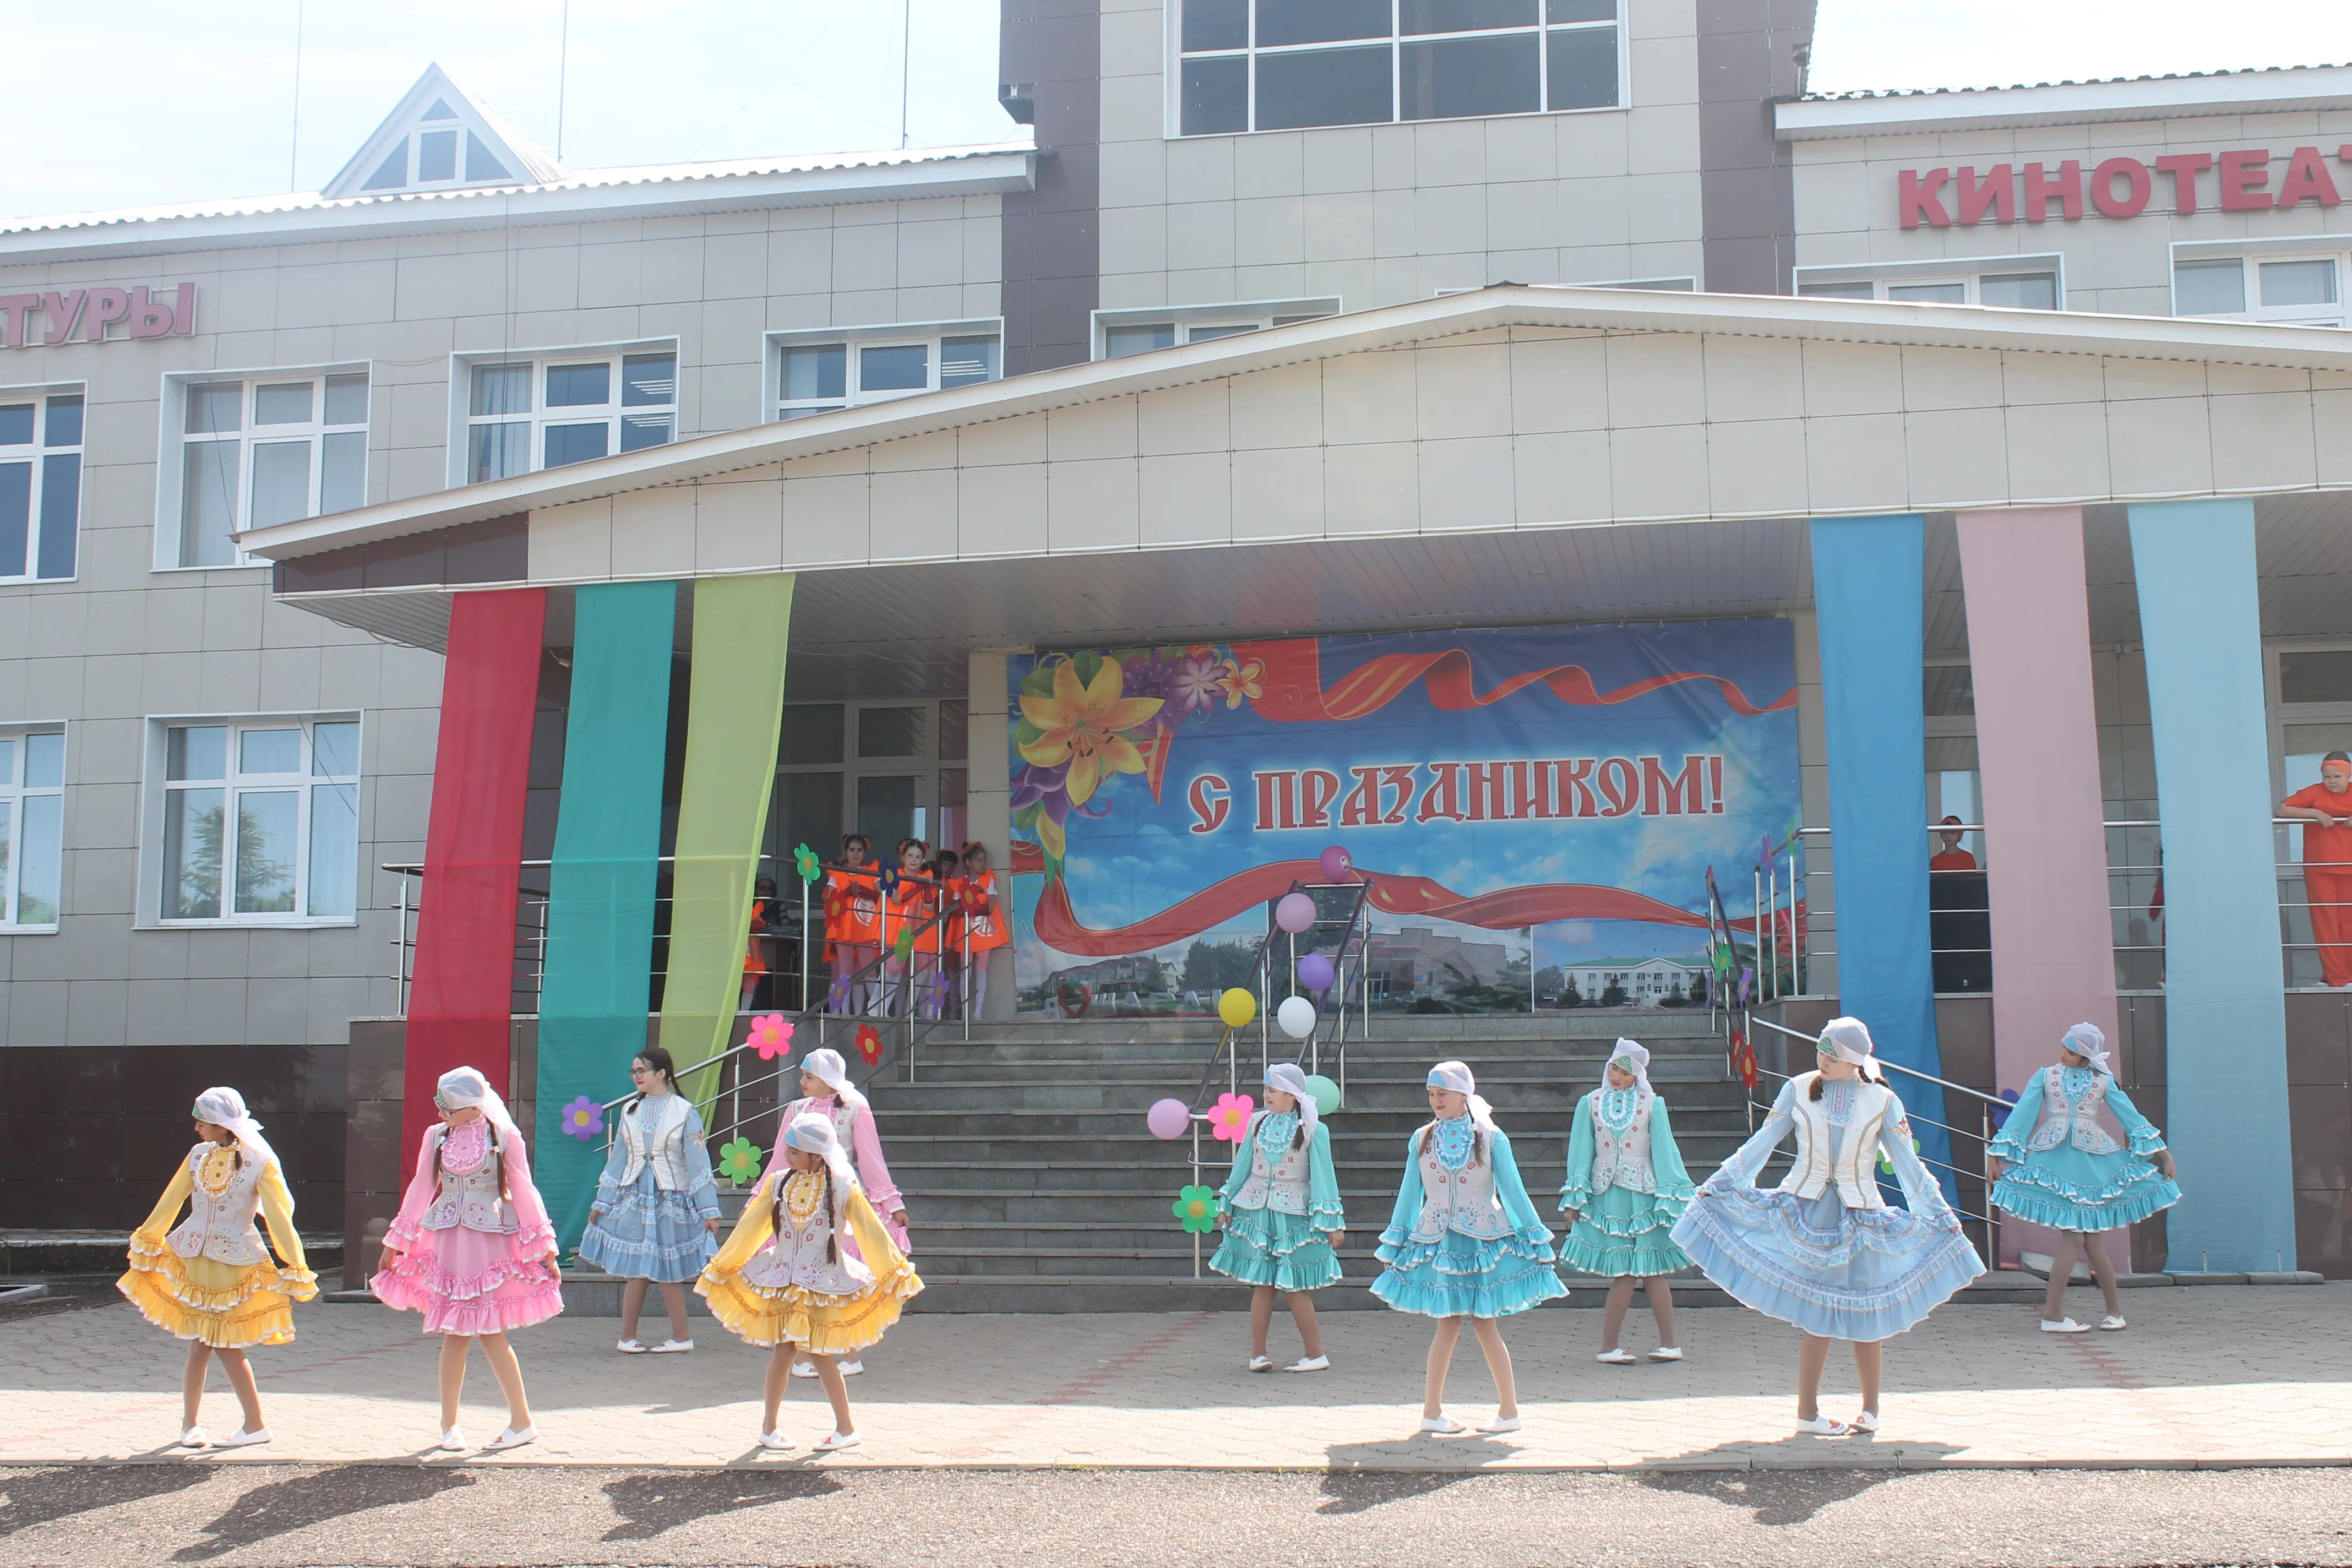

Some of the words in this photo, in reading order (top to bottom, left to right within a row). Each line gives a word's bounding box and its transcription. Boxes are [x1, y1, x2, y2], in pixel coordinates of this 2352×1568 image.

[1898, 144, 2352, 230] КИНОТЕА
[0, 282, 197, 347] ТУРЫ
[1188, 774, 1231, 834] С
[1254, 755, 1724, 830] ПРАЗДНИКОМ!
